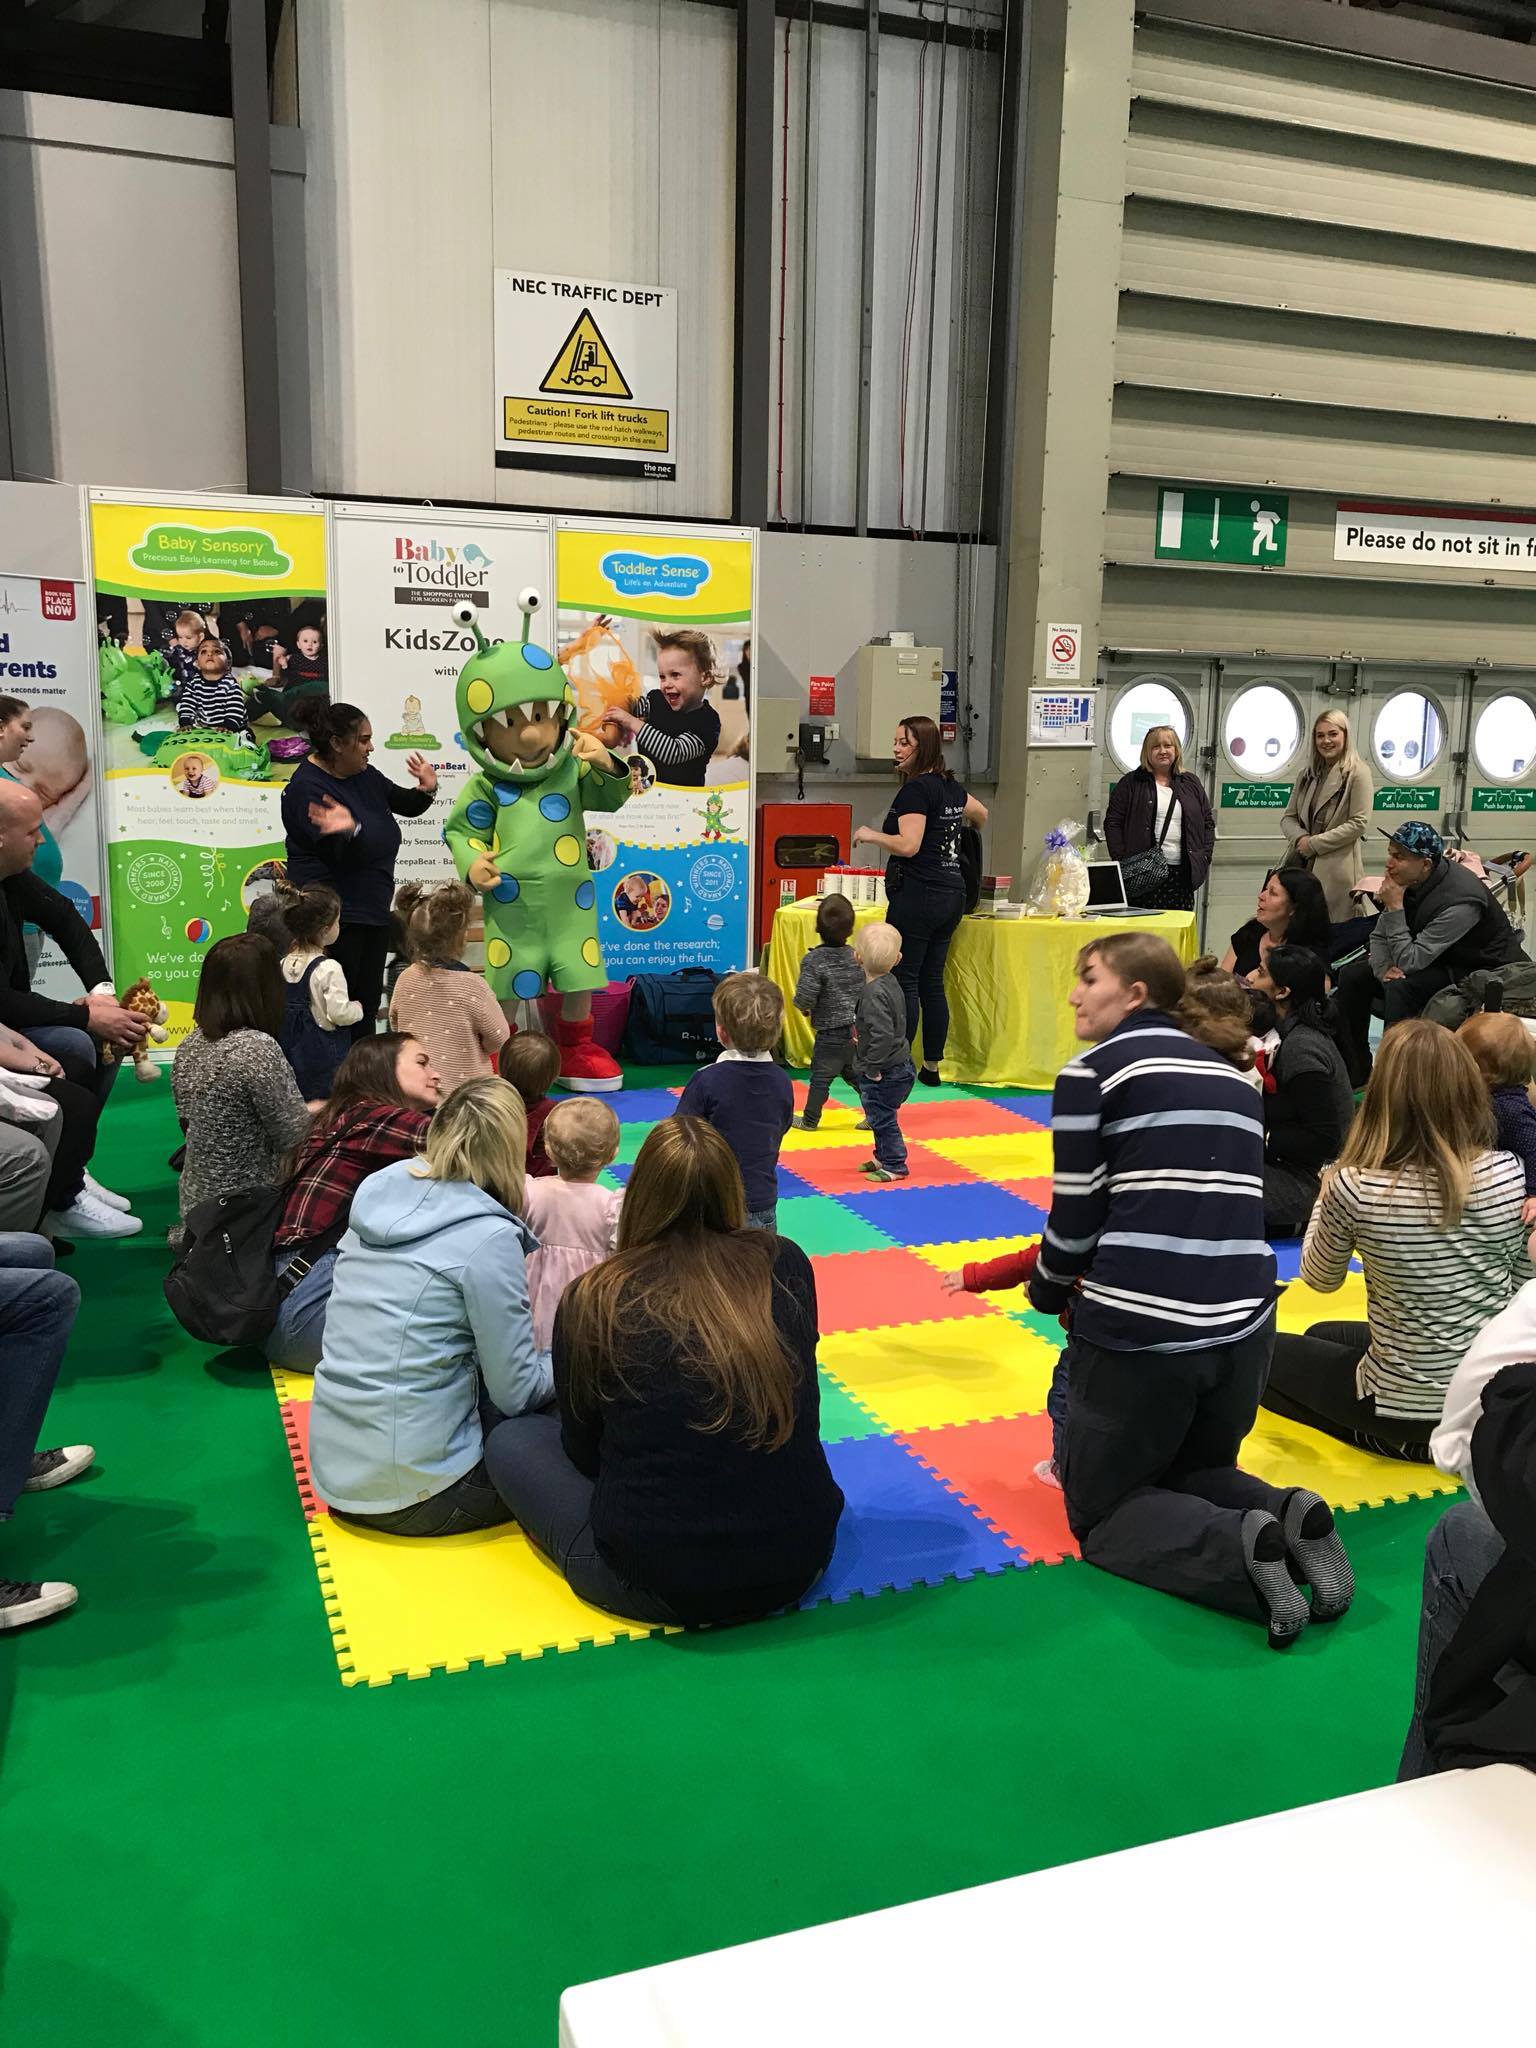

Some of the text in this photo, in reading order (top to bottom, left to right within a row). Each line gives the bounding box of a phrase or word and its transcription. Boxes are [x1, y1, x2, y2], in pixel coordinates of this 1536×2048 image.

[512, 278, 663, 307] NEC TRAFFIC DEPT
[527, 405, 648, 424] Caution! Fork lift trucks
[509, 416, 548, 427] Pedestrians
[553, 420, 575, 429] please
[589, 423, 600, 431] the
[614, 425, 632, 434] hatch
[518, 427, 554, 436] pedestrian
[591, 434, 621, 443] crossings
[629, 436, 642, 444] this
[643, 462, 657, 471] the
[158, 535, 264, 556] Baby Sensory
[1346, 527, 1406, 549] Please
[1412, 531, 1436, 550] do
[1442, 537, 1472, 553] not
[1478, 536, 1499, 555] sit
[1505, 537, 1520, 556] in
[395, 537, 463, 567] Baby
[143, 553, 280, 568] Precious Early Learning for Babies
[393, 561, 489, 588] to Toddler
[612, 560, 699, 578] Toddler Sense
[624, 578, 641, 587] Life's
[653, 580, 687, 589] Adventure
[45, 597, 72, 606] PLACE
[46, 604, 72, 617] NOW
[434, 666, 458, 676] with
[10, 686, 41, 695] seconds
[42, 687, 67, 695] matter
[126, 805, 146, 813] Most
[147, 805, 172, 813] babies
[173, 805, 194, 813] learn
[195, 805, 211, 813] best
[213, 805, 234, 813] when
[235, 805, 253, 815] they
[222, 817, 237, 825] and
[395, 818, 435, 827] eepaBeat
[143, 870, 166, 879] SINCE
[623, 940, 650, 951] done
[654, 940, 671, 951] the
[672, 939, 720, 951] research;
[146, 952, 184, 964] We've
[626, 956, 645, 965] can
[648, 954, 676, 967] enjoy
[678, 952, 695, 963] the
[147, 970, 162, 979] so
[165, 970, 190, 982] you
